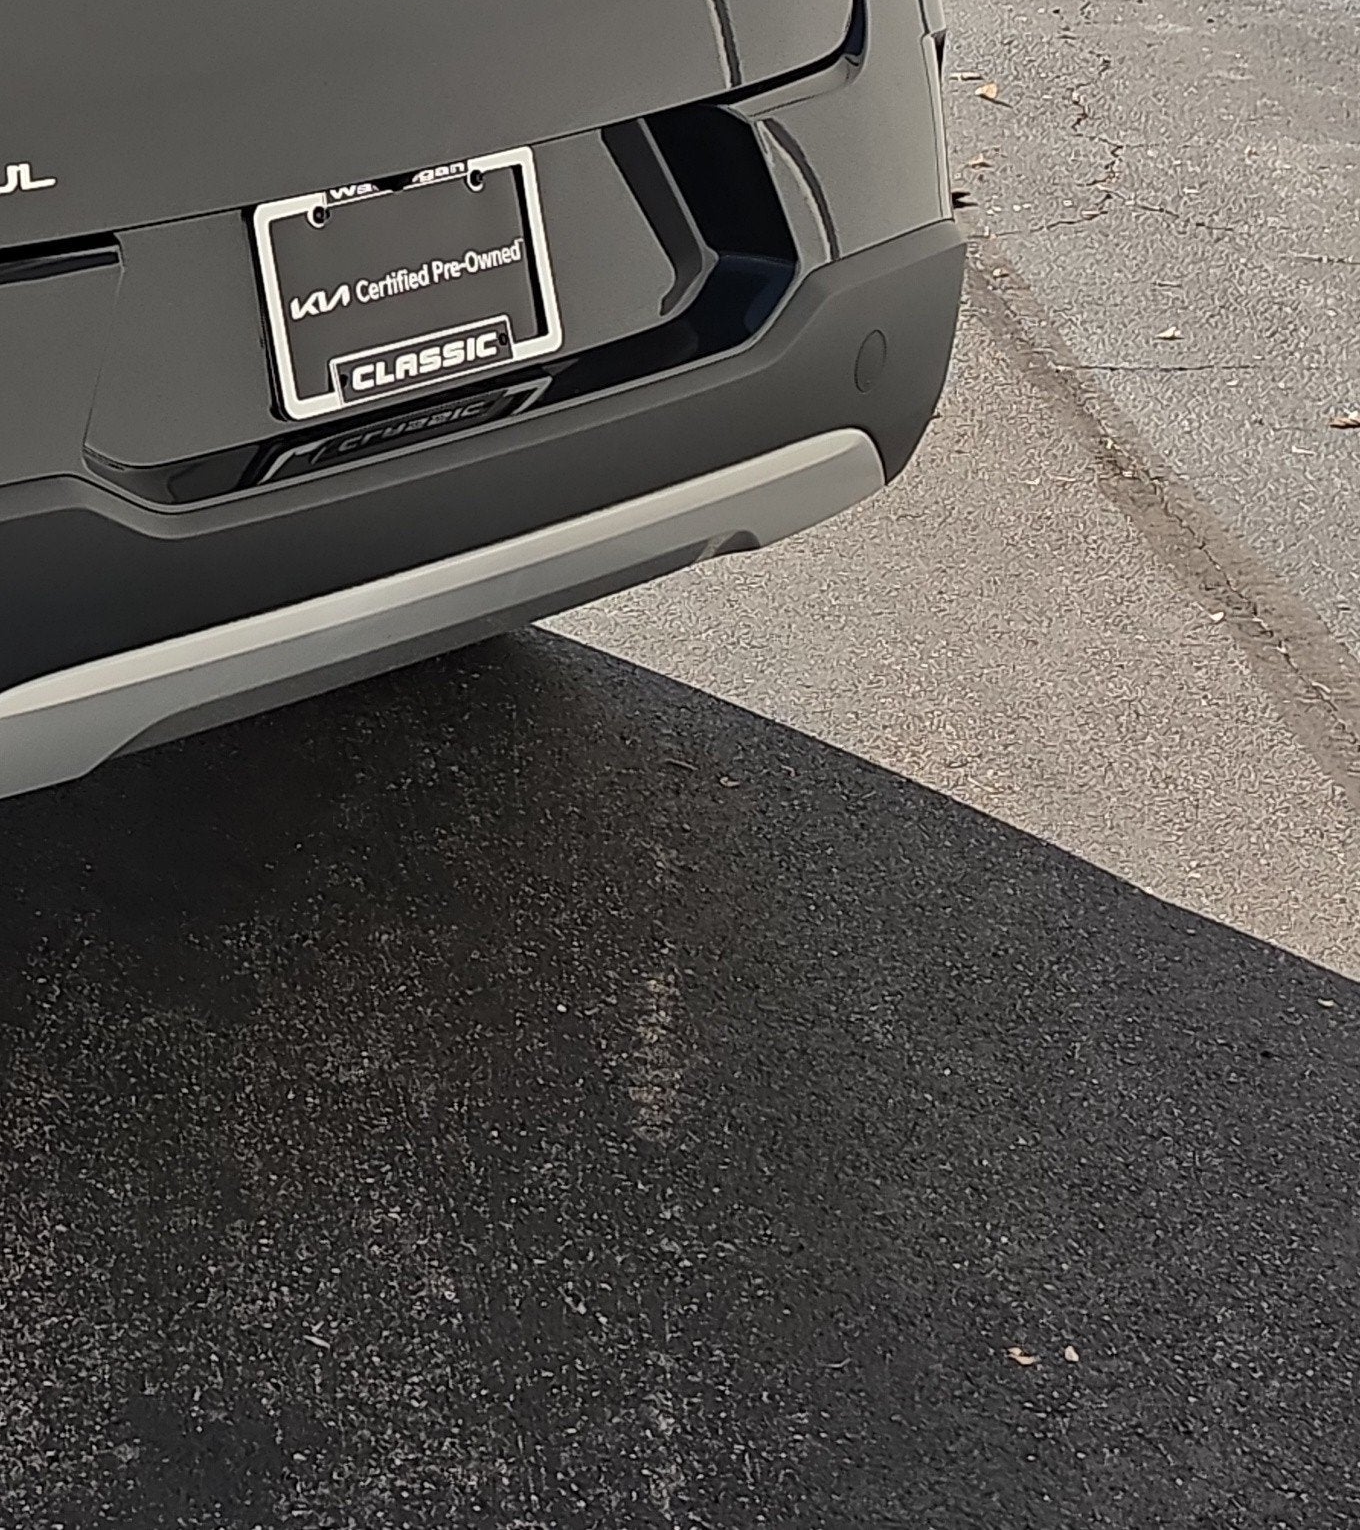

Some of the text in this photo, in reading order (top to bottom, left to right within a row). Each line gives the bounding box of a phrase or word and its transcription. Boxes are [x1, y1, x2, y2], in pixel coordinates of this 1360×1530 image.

[290, 284, 351, 320] KIA
[355, 263, 430, 303] Certified
[352, 331, 498, 391] CLASSIC
